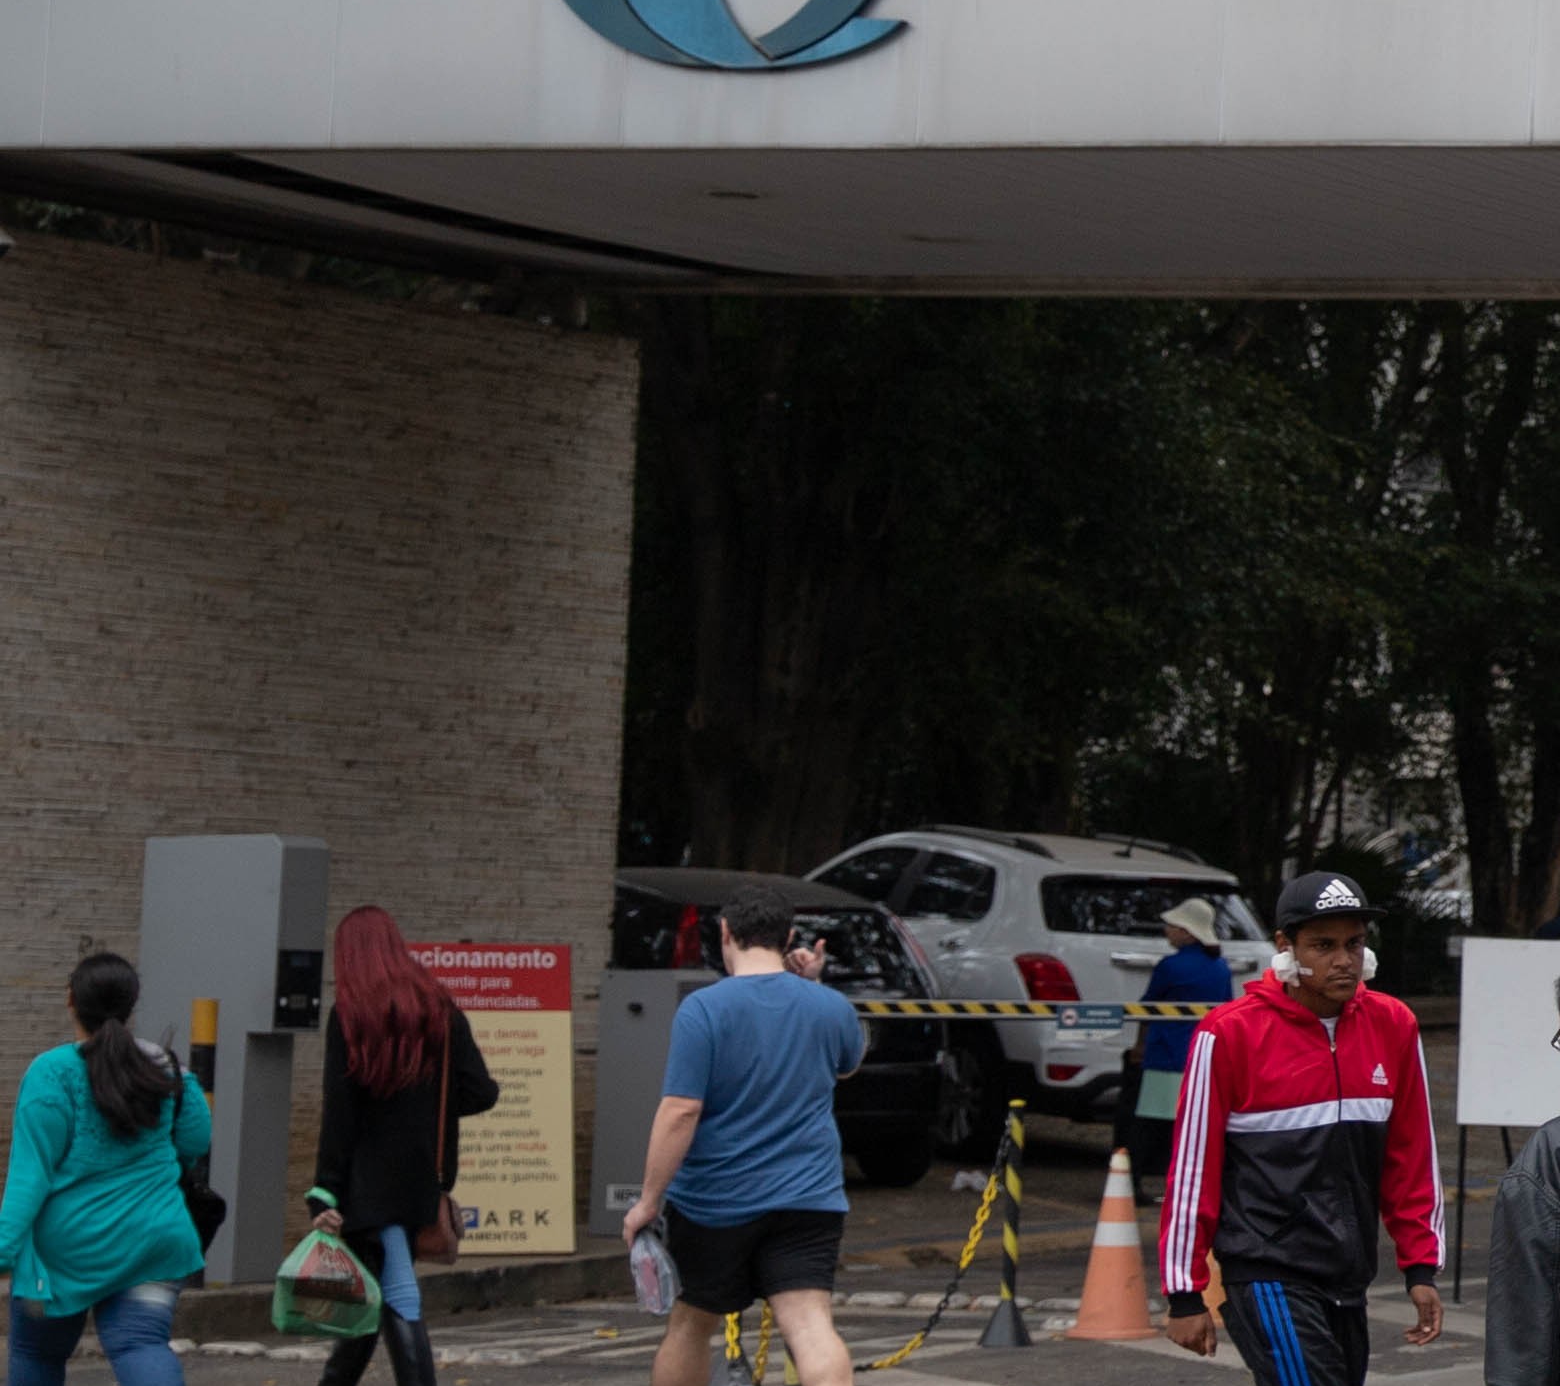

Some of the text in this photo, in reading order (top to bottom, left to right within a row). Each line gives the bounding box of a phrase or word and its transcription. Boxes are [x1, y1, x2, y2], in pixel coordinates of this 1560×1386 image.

[1315, 895, 1362, 910] adidas
[409, 946, 557, 969] cionamento
[438, 975, 477, 989] mente
